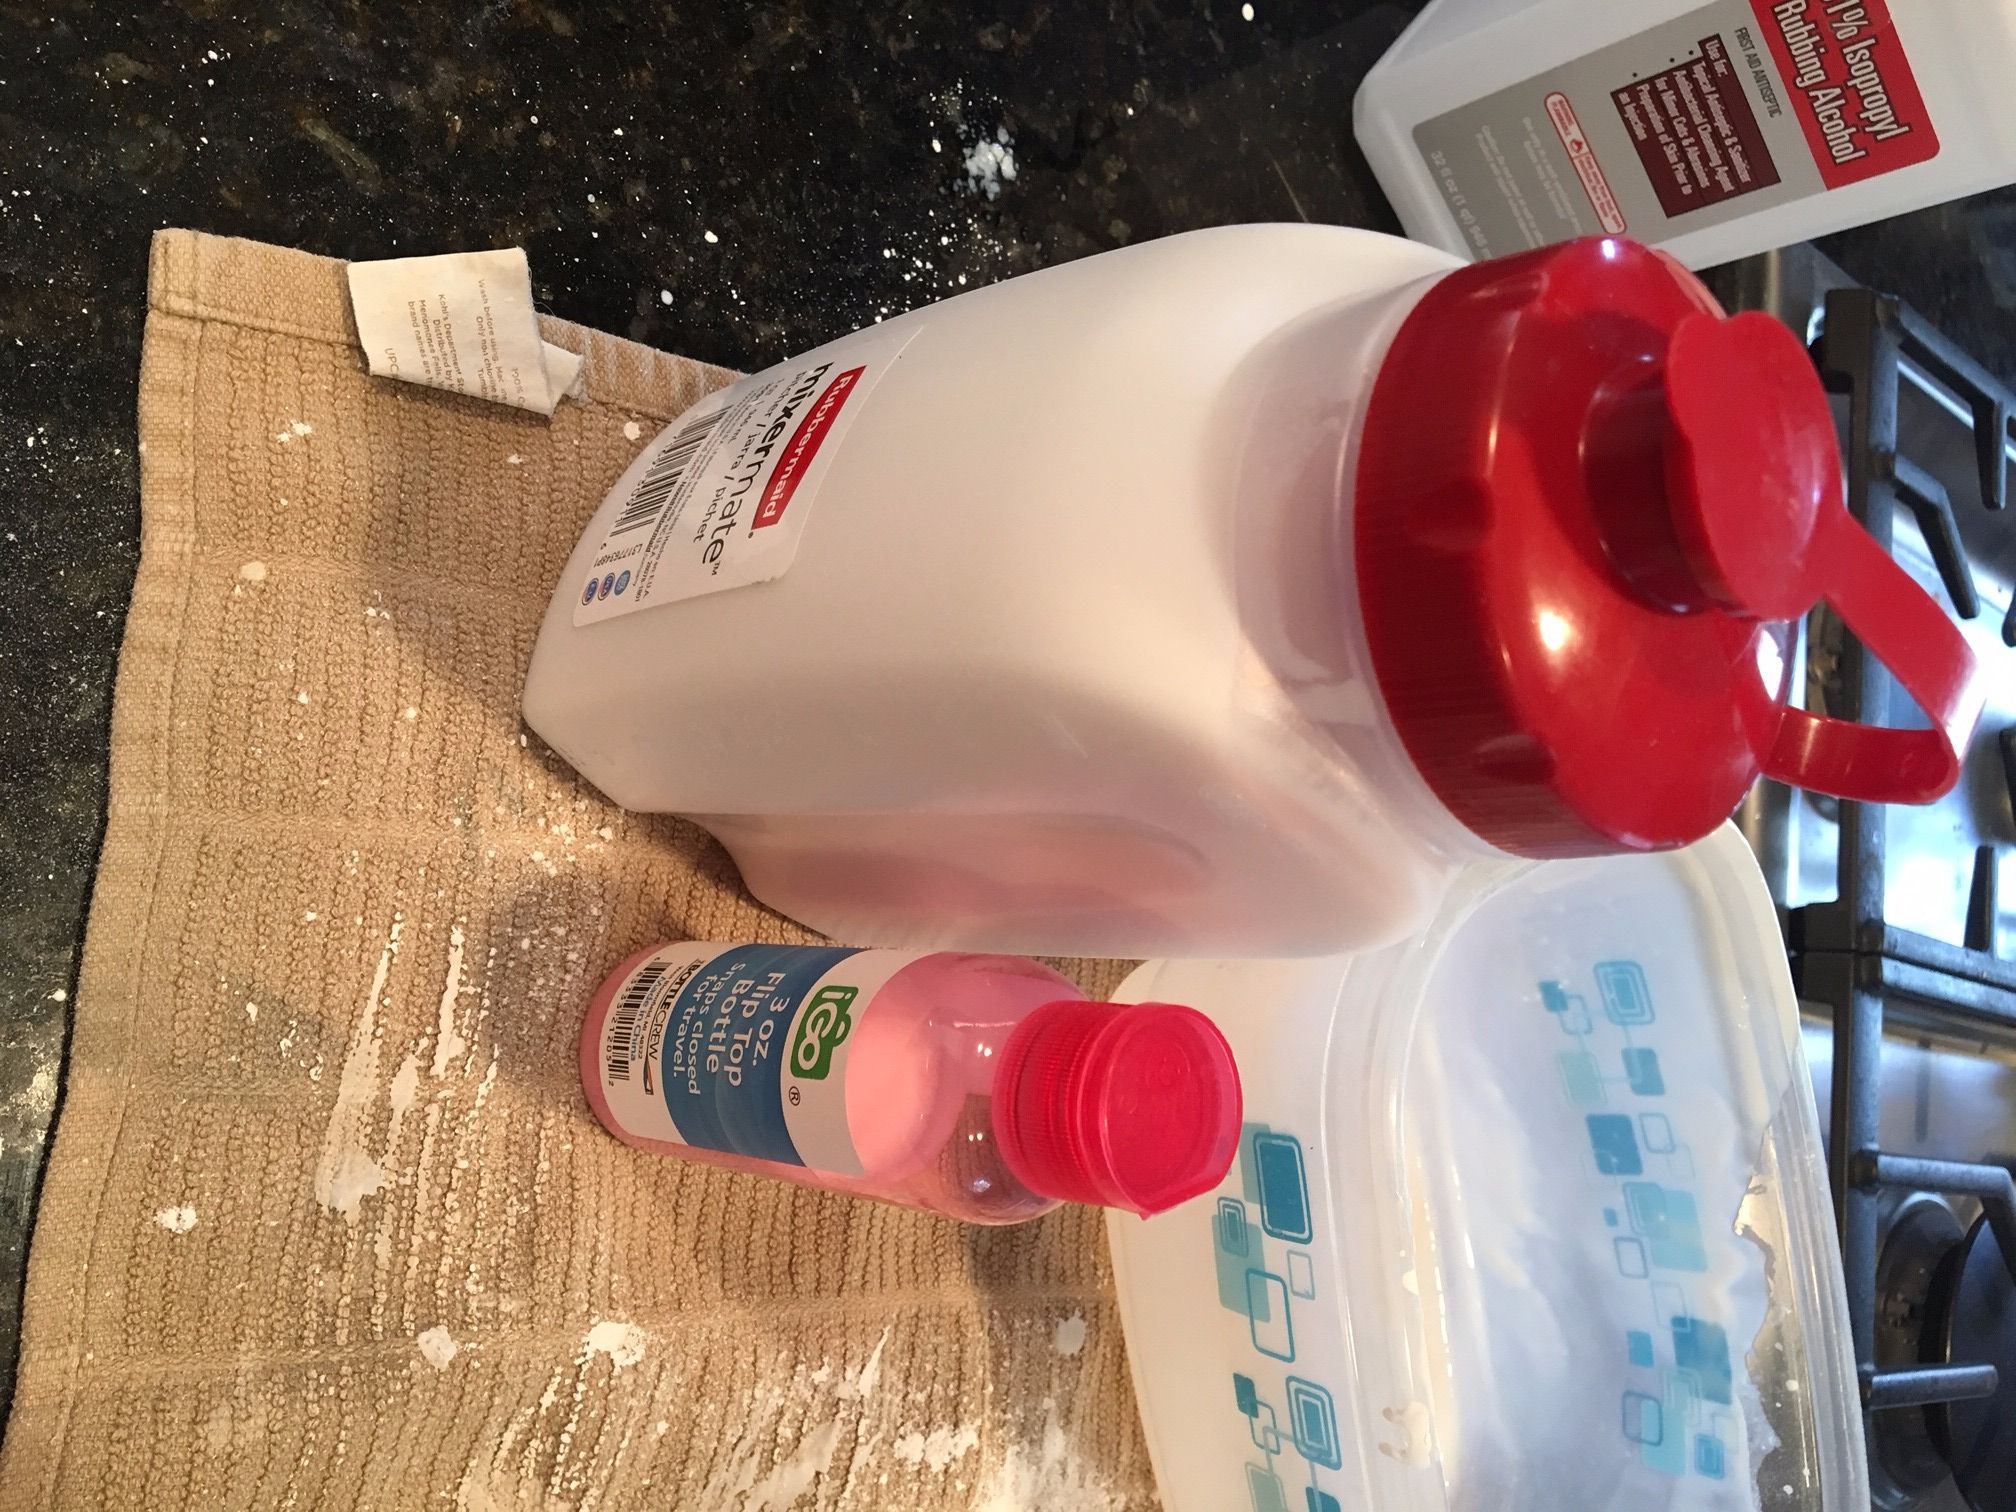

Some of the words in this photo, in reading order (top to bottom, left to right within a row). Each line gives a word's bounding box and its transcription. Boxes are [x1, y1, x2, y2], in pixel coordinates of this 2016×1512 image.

[1734, 27, 1755, 53] FIRST
[1824, 0, 1869, 40] 1%
[1706, 40, 1720, 60] Use
[1745, 53, 1761, 69] AID
[1752, 68, 1782, 118] ANTISEPTIC
[1774, 0, 1826, 88] Rubbing
[1808, 87, 1866, 165] Alcohol
[1842, 38, 1909, 141] Isopropyl
[408, 301, 420, 328] brand
[476, 316, 485, 336] Only
[484, 306, 494, 336] before
[731, 433, 760, 470] jarra
[762, 375, 853, 518] Rubbermaid
[693, 487, 727, 543] pichet
[642, 975, 667, 1008] Made
[693, 974, 717, 1001] for
[699, 962, 747, 1015] Snaps
[741, 972, 787, 1018] Flip
[769, 996, 790, 1012] 3
[637, 1012, 645, 1022] in
[648, 963, 701, 1061] BOTTLECREW
[706, 979, 755, 1073] Bottle
[630, 1025, 642, 1062] China
[673, 1005, 696, 1079] travel.
[687, 1020, 703, 1095] closed
[724, 1028, 753, 1087] Top
[752, 1019, 774, 1066] oz.
